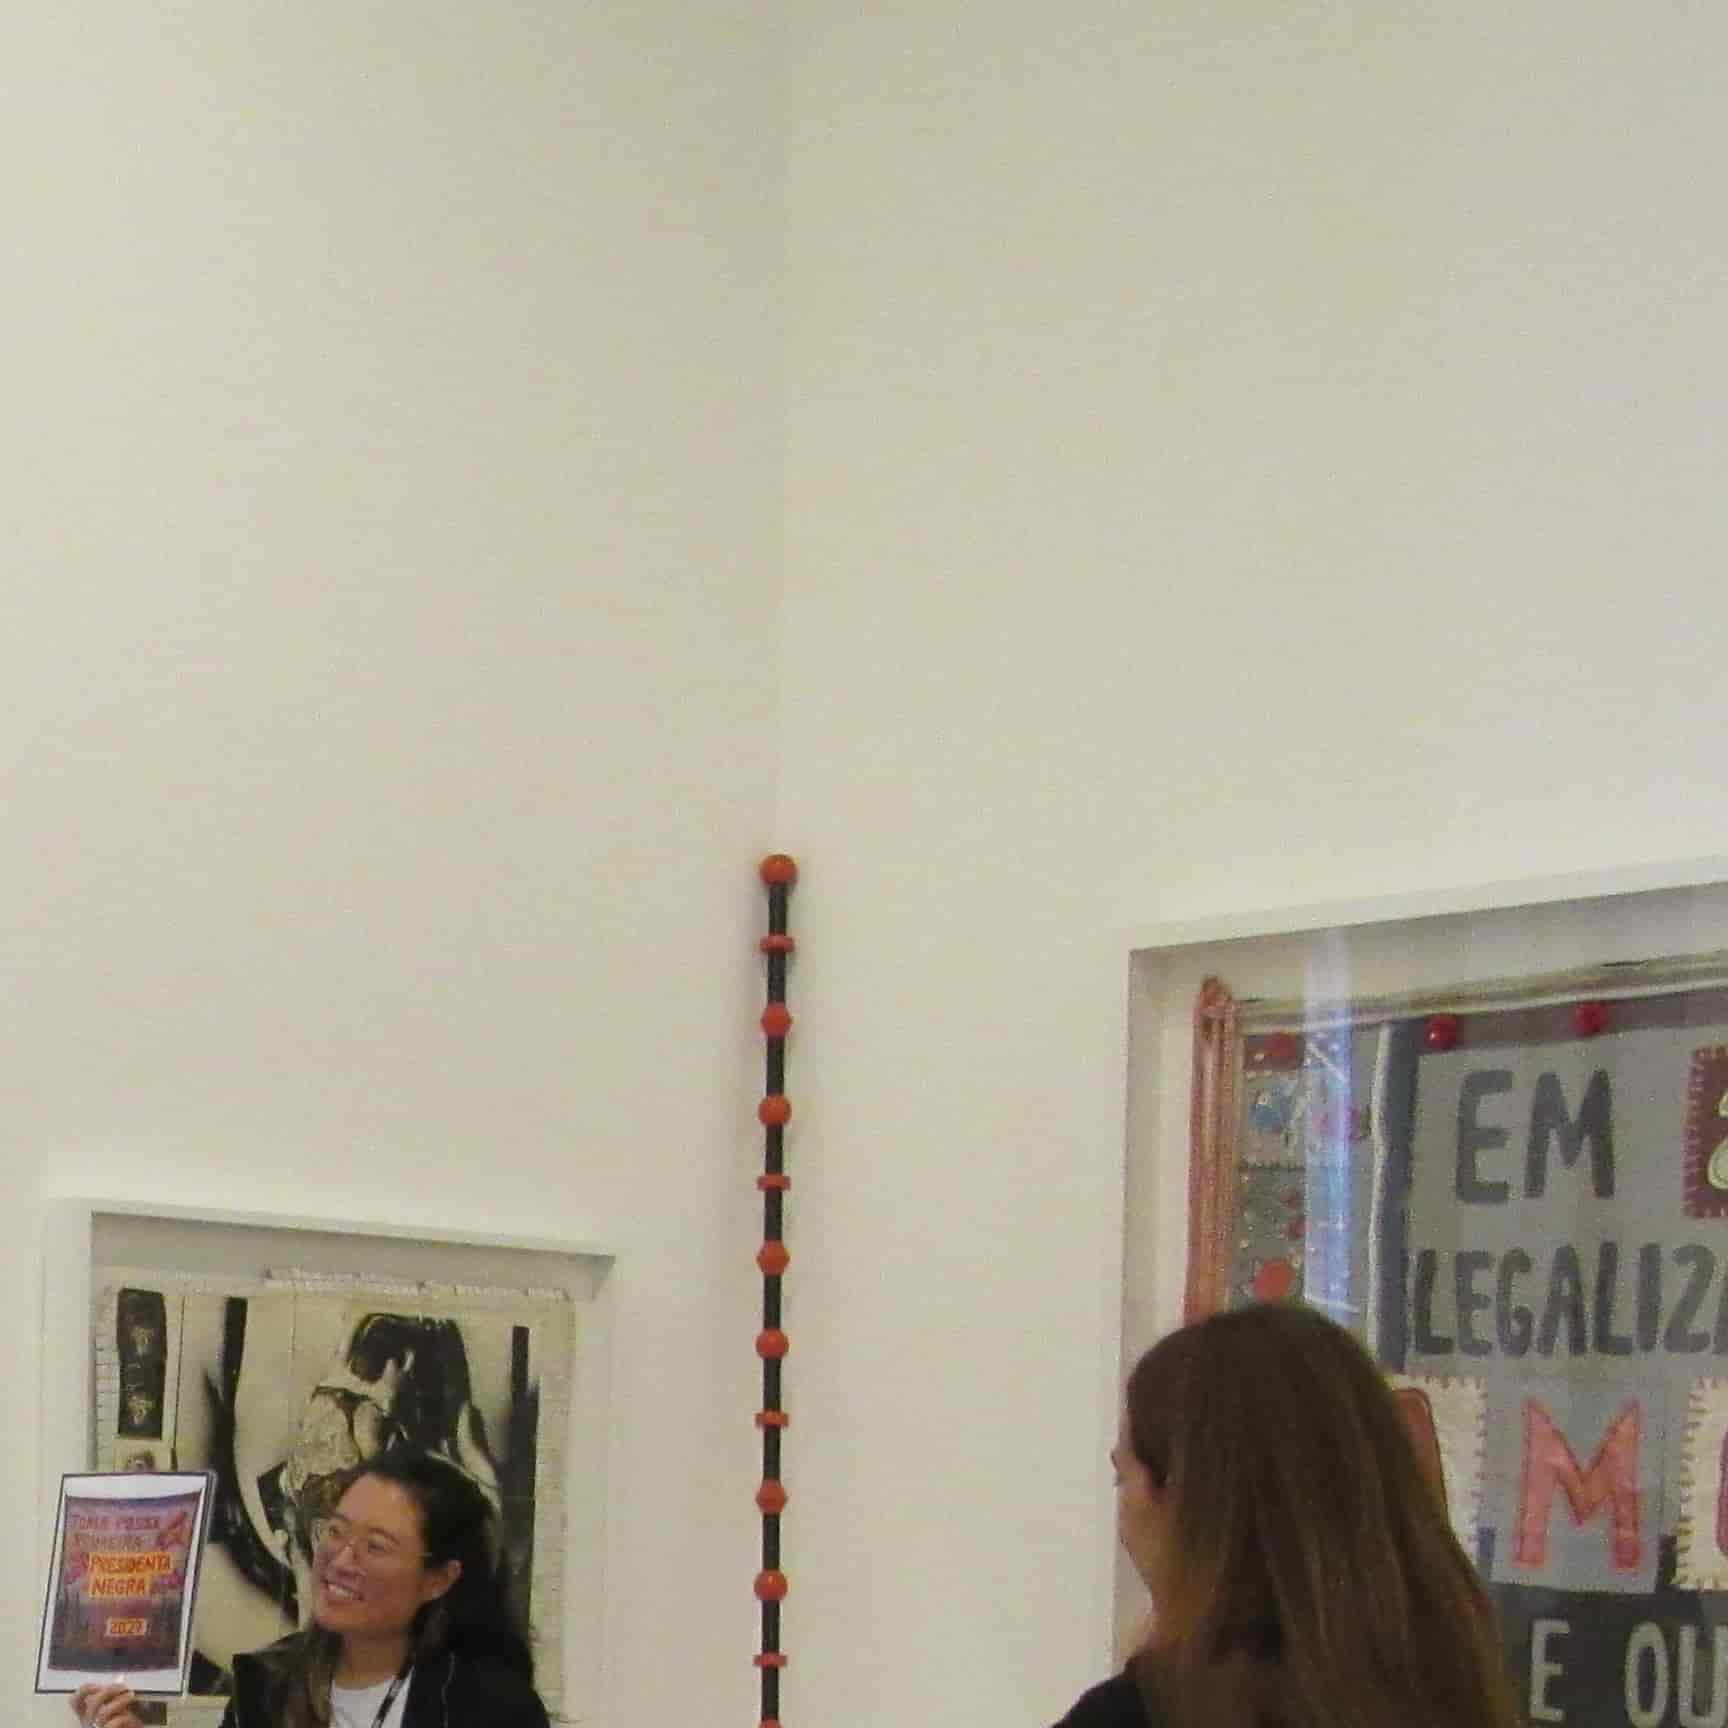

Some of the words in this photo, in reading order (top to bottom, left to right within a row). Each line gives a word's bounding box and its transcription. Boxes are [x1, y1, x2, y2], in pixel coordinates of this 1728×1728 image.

[1455, 1067, 1616, 1205] EM
[1413, 1241, 1728, 1357] LEGALIZ
[92, 1577, 146, 1597] NEGRA
